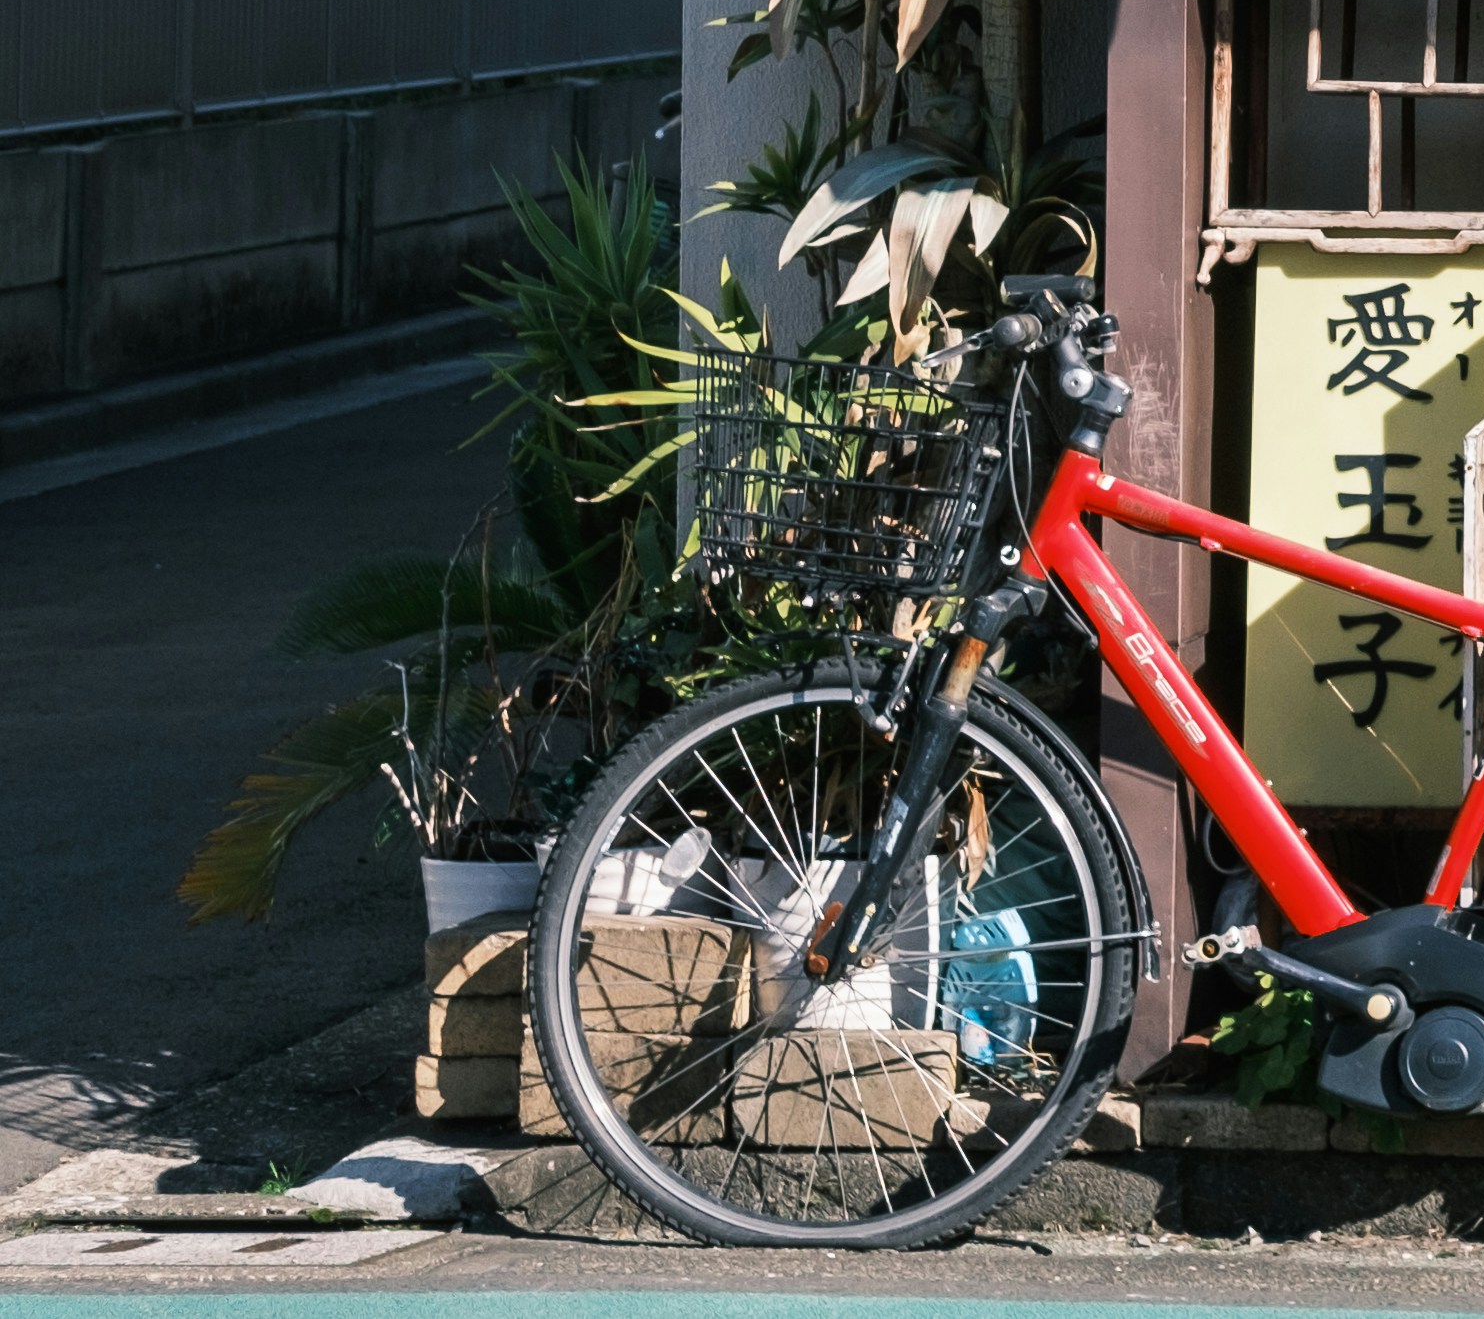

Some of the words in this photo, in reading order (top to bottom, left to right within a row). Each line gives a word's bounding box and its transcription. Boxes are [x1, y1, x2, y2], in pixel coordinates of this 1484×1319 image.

[1313, 281, 1437, 729] 愛玉子
[1124, 631, 1208, 744] Brace
